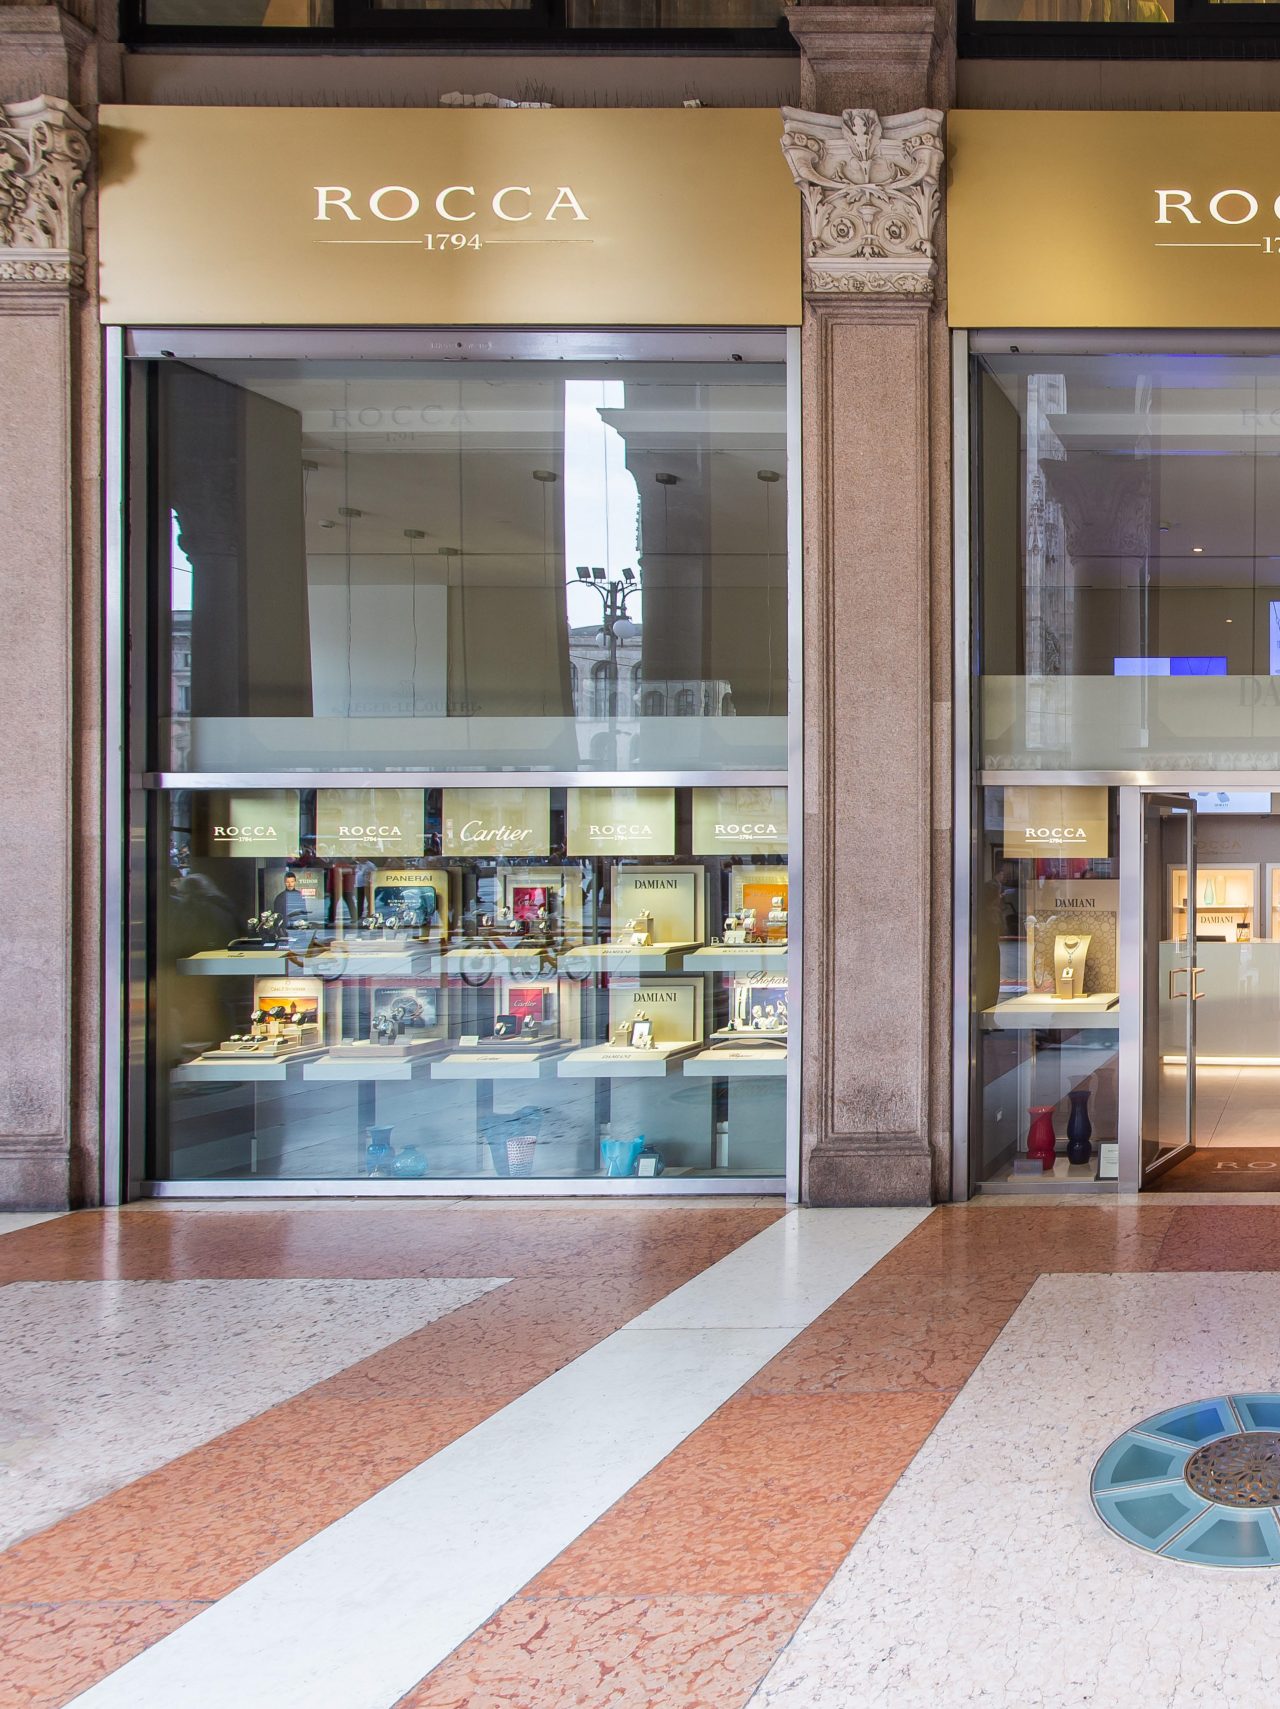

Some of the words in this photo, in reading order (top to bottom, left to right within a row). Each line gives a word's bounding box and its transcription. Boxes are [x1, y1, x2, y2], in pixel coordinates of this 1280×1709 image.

[313, 185, 590, 222] ROCCA
[424, 233, 483, 250] 1794
[329, 404, 471, 428] ROCCA
[213, 826, 277, 836] ROCCA
[339, 826, 401, 836] ROCCA
[460, 820, 532, 841] Cartier
[589, 825, 652, 835] ROCCA
[714, 824, 777, 834] ROCCA
[1025, 828, 1086, 838] ROCCA
[1196, 840, 1242, 849] OCCA
[634, 880, 678, 890] DAMIANI
[1055, 899, 1095, 908] DAMIANI
[1200, 916, 1233, 924] DAMIANI
[633, 992, 677, 1002] DAMIANI
[513, 999, 537, 1007] Cartier
